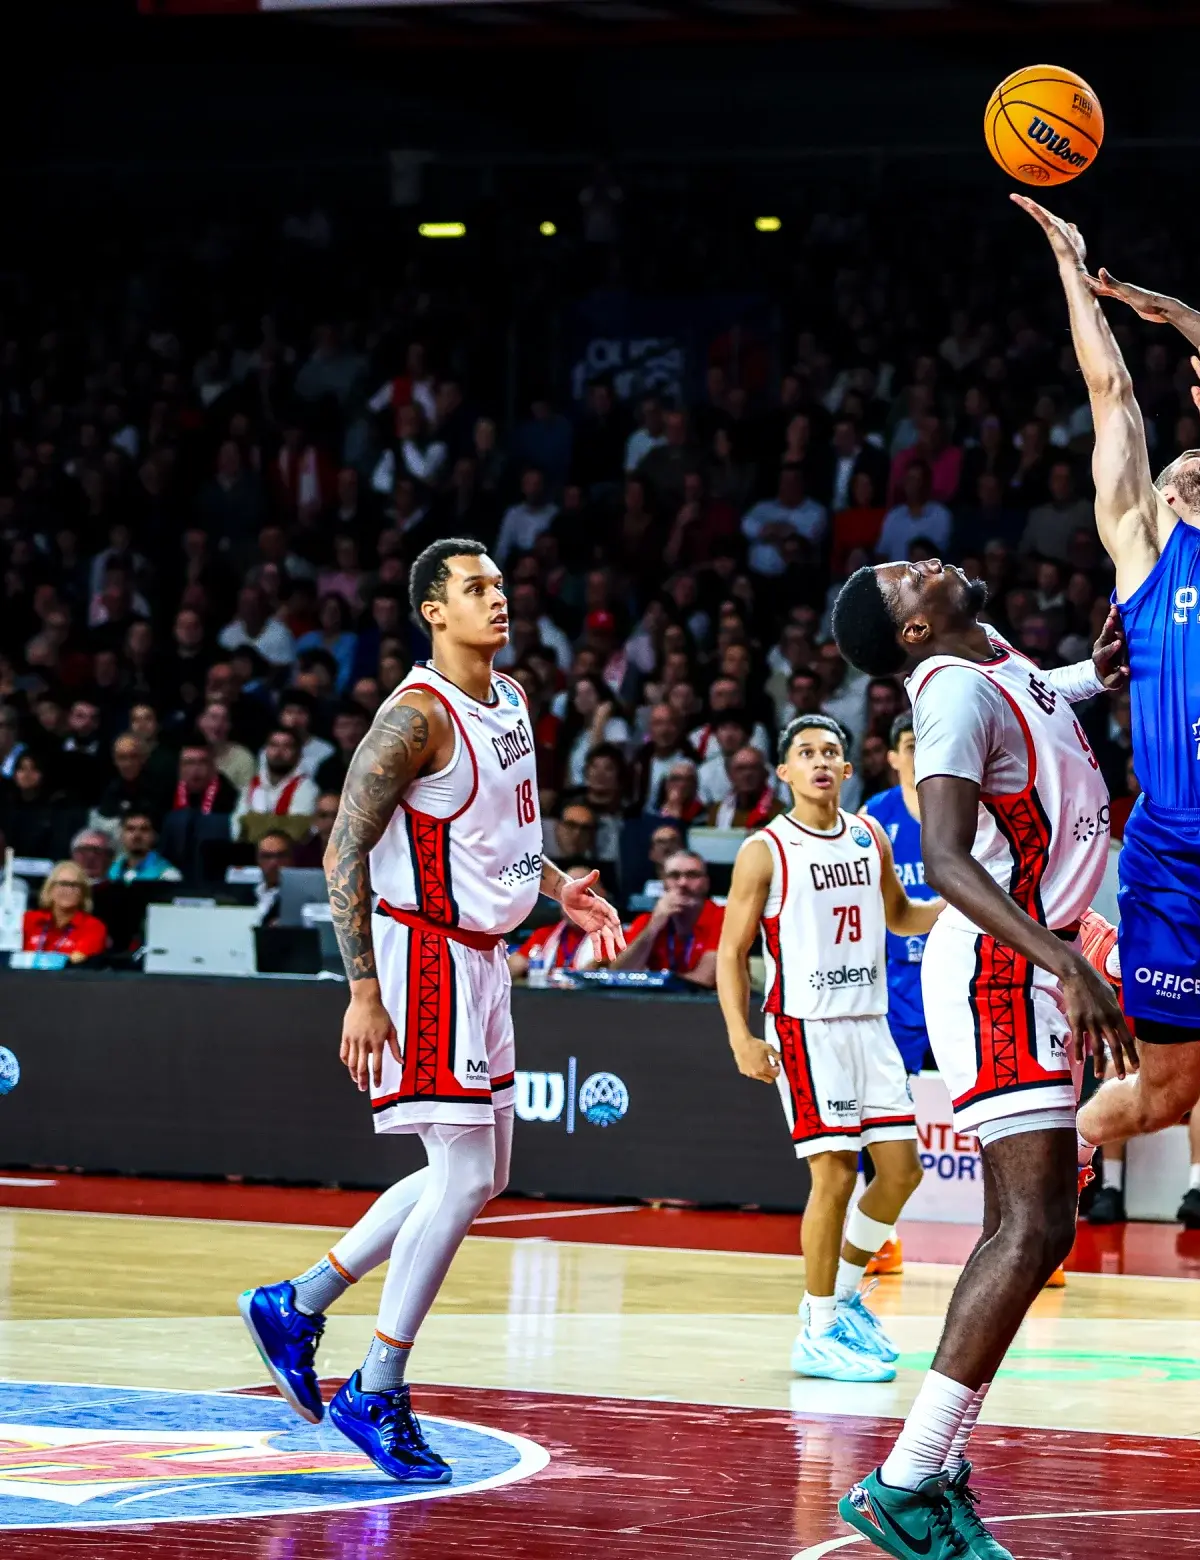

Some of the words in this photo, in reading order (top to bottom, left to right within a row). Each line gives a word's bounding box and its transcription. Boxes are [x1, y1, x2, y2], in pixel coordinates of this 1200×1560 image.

[1027, 115, 1089, 168] Wilson
[491, 718, 534, 771] CHOLET
[514, 777, 537, 829] 18
[512, 852, 542, 879] sole
[810, 857, 872, 891] CHOLET
[832, 905, 863, 945] 79
[1155, 989, 1181, 1000] SHOES
[916, 1122, 980, 1153] NTE
[919, 1153, 982, 1180] POR
